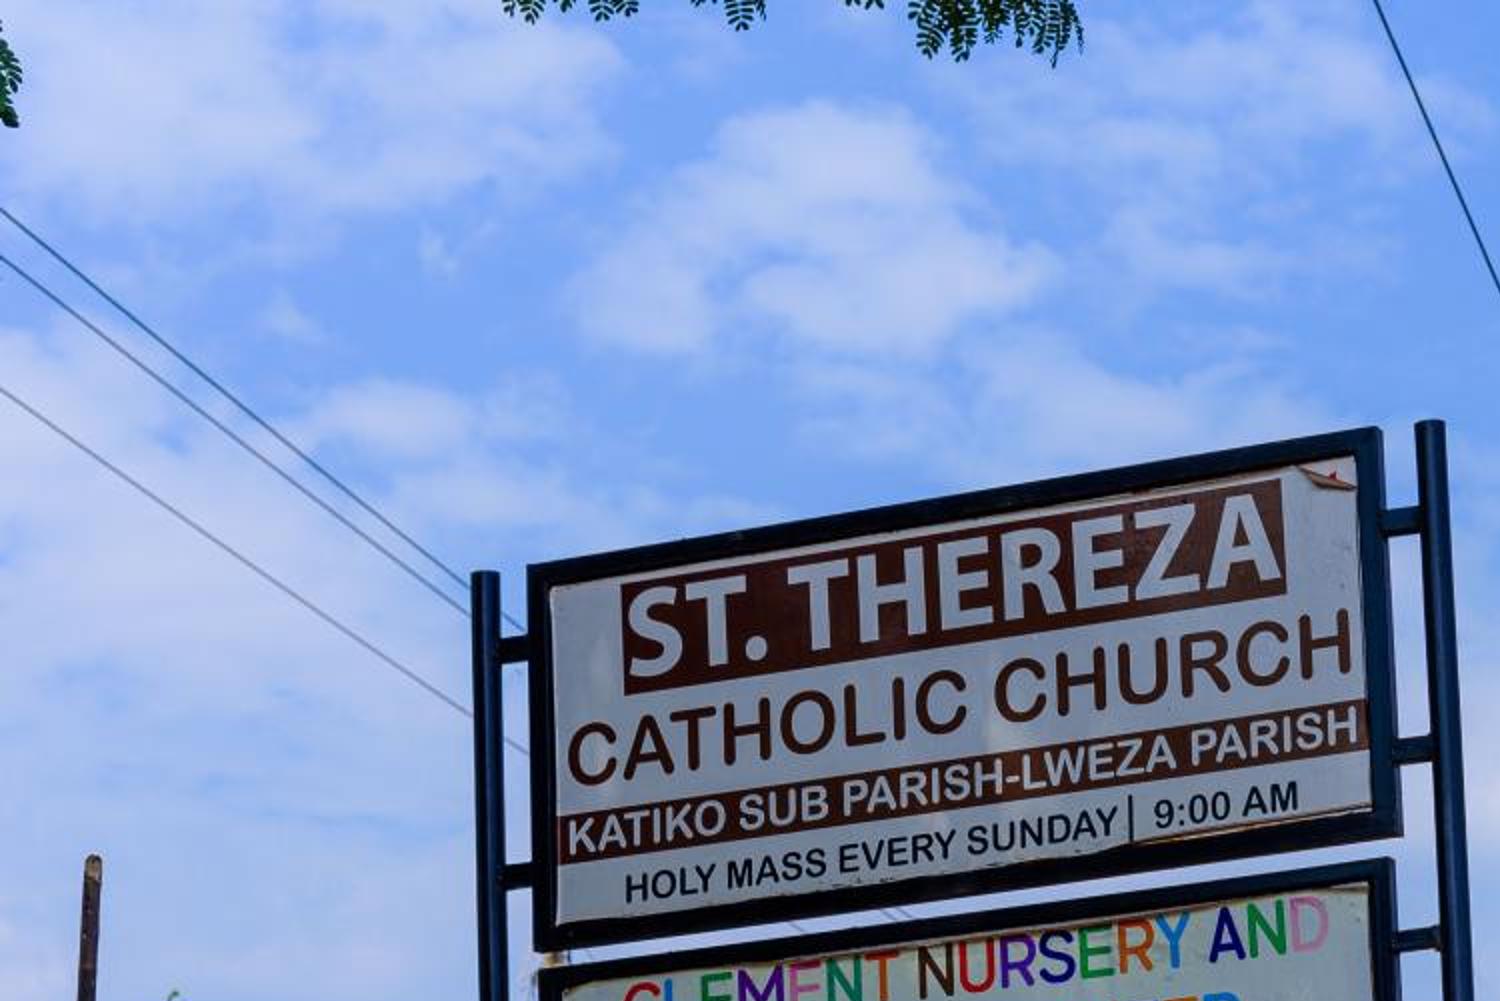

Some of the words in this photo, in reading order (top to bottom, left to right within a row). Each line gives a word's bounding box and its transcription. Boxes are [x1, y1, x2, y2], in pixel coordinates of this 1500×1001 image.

[628, 576, 768, 677] ST.
[788, 494, 1281, 652] THEREZA
[568, 669, 967, 785] CATHOLIC
[994, 607, 1352, 723] CHURCH
[568, 800, 726, 856] KATIKO
[740, 785, 829, 831] SUB
[843, 734, 1177, 817] PARISH-LWEZA
[1190, 705, 1357, 767] PARISH
[625, 864, 716, 903] HOLY
[727, 851, 826, 890] MASS
[838, 829, 957, 873] EVERY
[967, 805, 1118, 854] SUNDAY
[1153, 791, 1231, 829] 9:00
[1242, 781, 1298, 817] AM
[917, 911, 1191, 1000] NURSERY
[1209, 896, 1329, 963] AND
